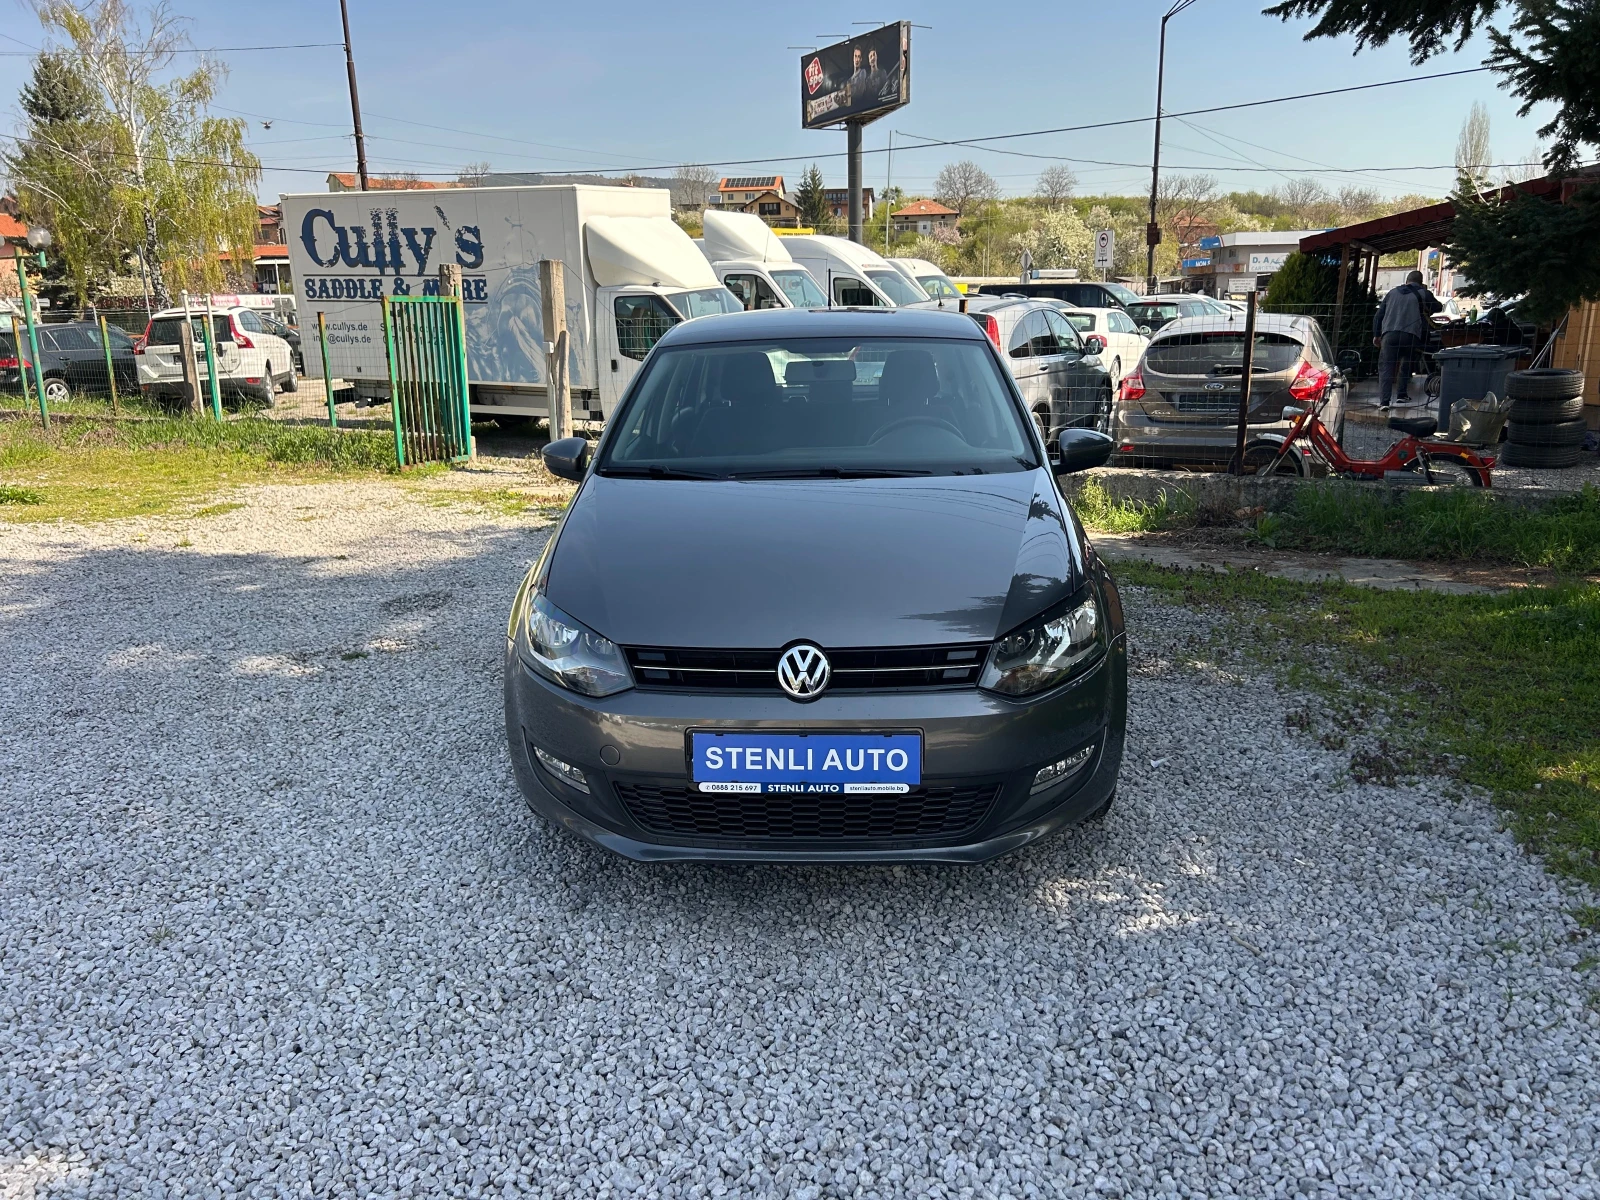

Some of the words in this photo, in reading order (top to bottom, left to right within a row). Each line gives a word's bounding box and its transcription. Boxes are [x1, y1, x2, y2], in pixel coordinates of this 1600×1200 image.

[304, 278, 383, 300] SADDLE
[393, 277, 410, 297] &
[423, 278, 488, 300] MRE
[312, 333, 372, 345] in@cullys.de
[705, 746, 813, 770] STENLI
[821, 748, 909, 771] AUTO
[767, 784, 804, 793] STENLI
[808, 784, 840, 793] AUTO
